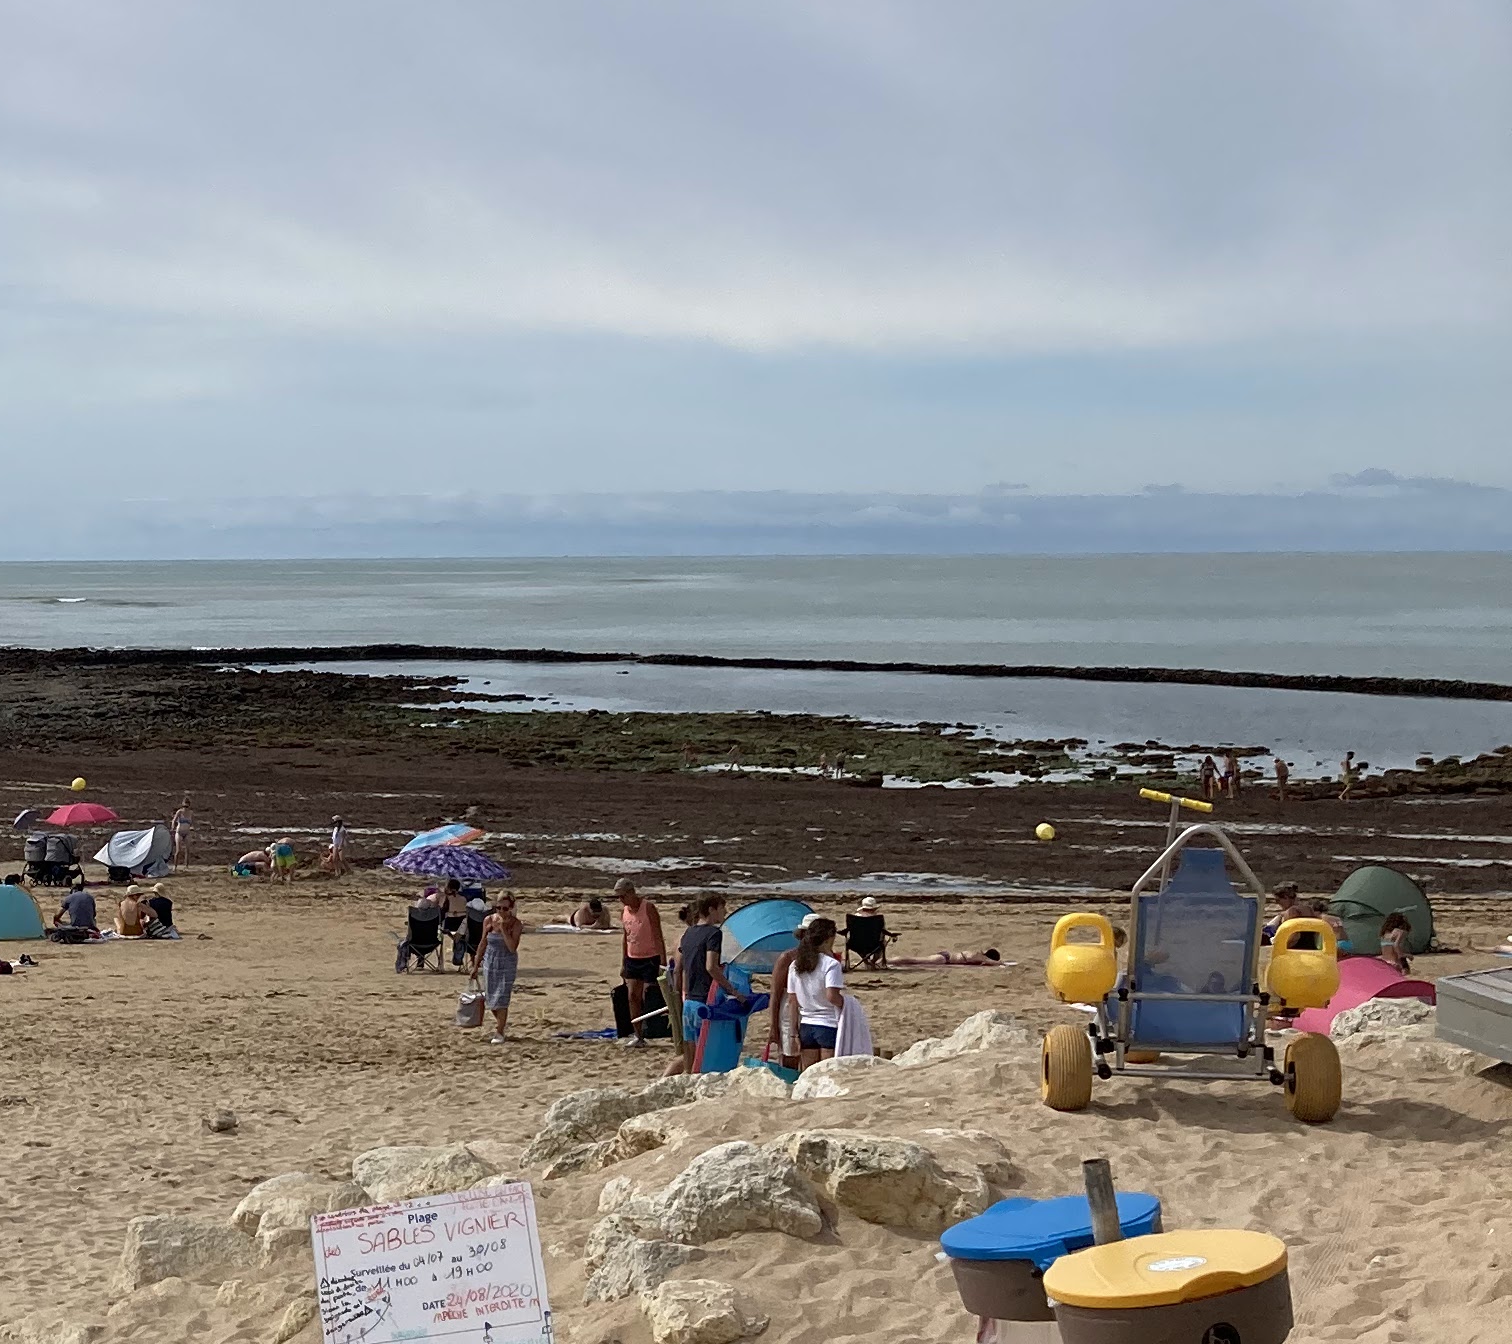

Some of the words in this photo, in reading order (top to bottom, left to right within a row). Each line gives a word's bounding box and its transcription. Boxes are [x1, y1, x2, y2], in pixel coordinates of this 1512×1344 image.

[407, 1212, 438, 1225] Plage
[357, 1224, 436, 1255] SABLES
[443, 1211, 526, 1243] VIGNIER
[350, 1264, 397, 1277] Surveillée
[398, 1262, 411, 1271] du
[451, 1255, 463, 1264] au
[355, 1283, 368, 1293] de
[422, 1299, 446, 1311] DATE
